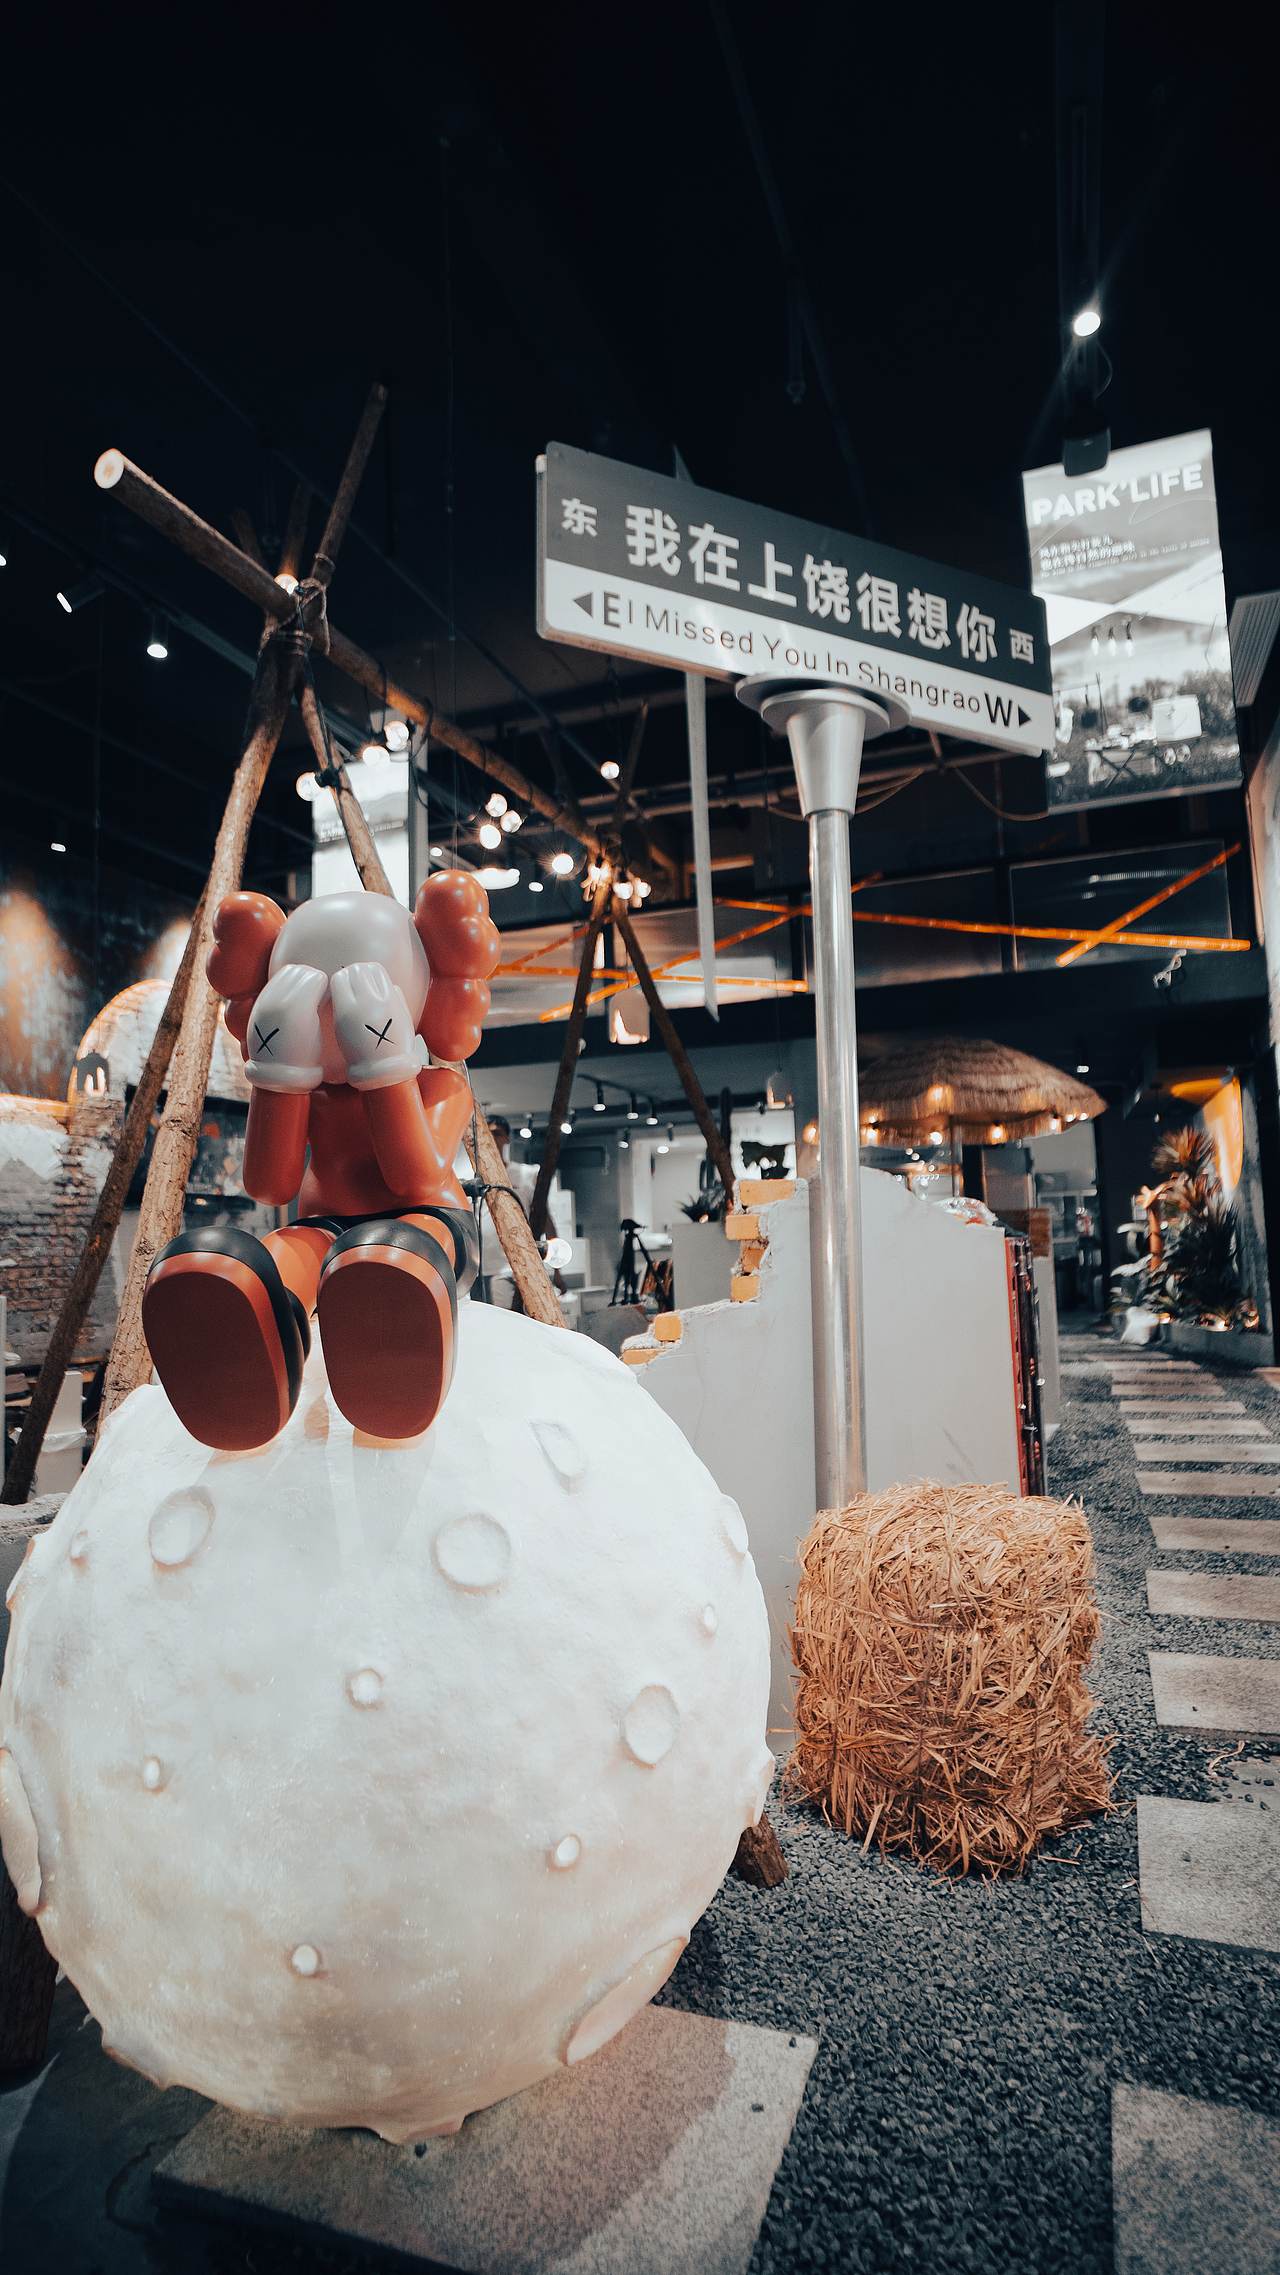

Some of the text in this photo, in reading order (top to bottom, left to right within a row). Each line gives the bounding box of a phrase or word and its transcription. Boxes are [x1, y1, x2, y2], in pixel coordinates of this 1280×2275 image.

[561, 498, 1034, 665] 东 我在上饶很想你 西
[603, 590, 622, 629] E
[646, 603, 754, 655] Missed
[763, 634, 818, 671] You
[826, 651, 849, 676] In
[858, 661, 981, 714] Shangrao
[984, 690, 1013, 728] W
